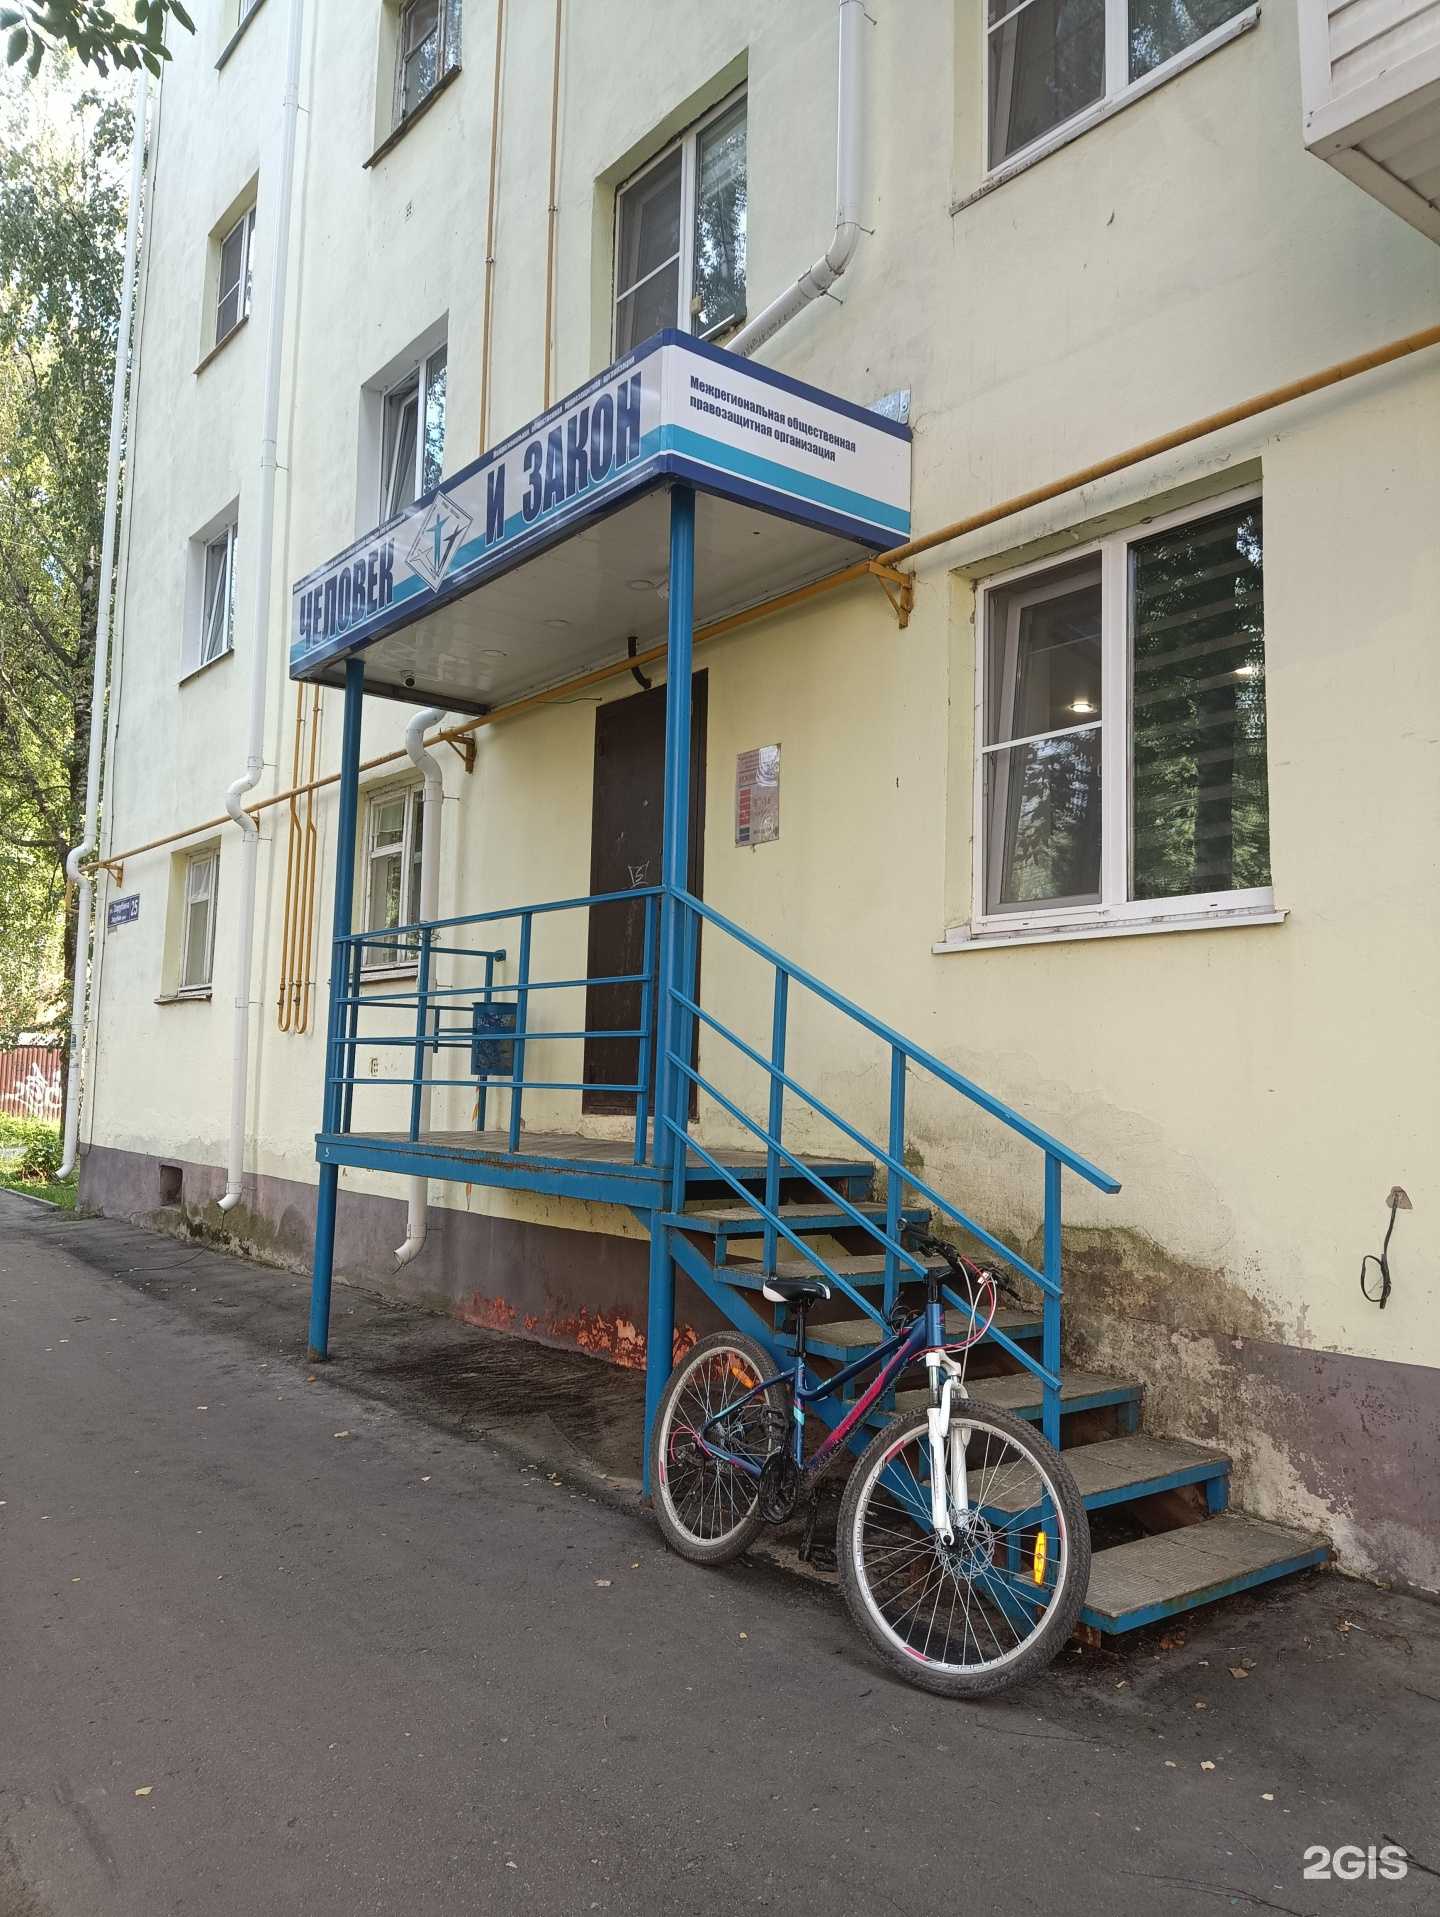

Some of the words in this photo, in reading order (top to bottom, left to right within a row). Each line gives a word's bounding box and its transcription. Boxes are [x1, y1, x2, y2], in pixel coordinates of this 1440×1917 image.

[690, 375, 785, 425] Межрегиональная
[787, 416, 856, 453] общественная
[690, 396, 773, 437] правозащитная
[774, 429, 836, 462] организация
[299, 538, 394, 651] ЧЕЛОВЕК
[486, 463, 505, 546] И
[522, 371, 641, 523] ЗАКОН
[130, 898, 138, 916] 25
